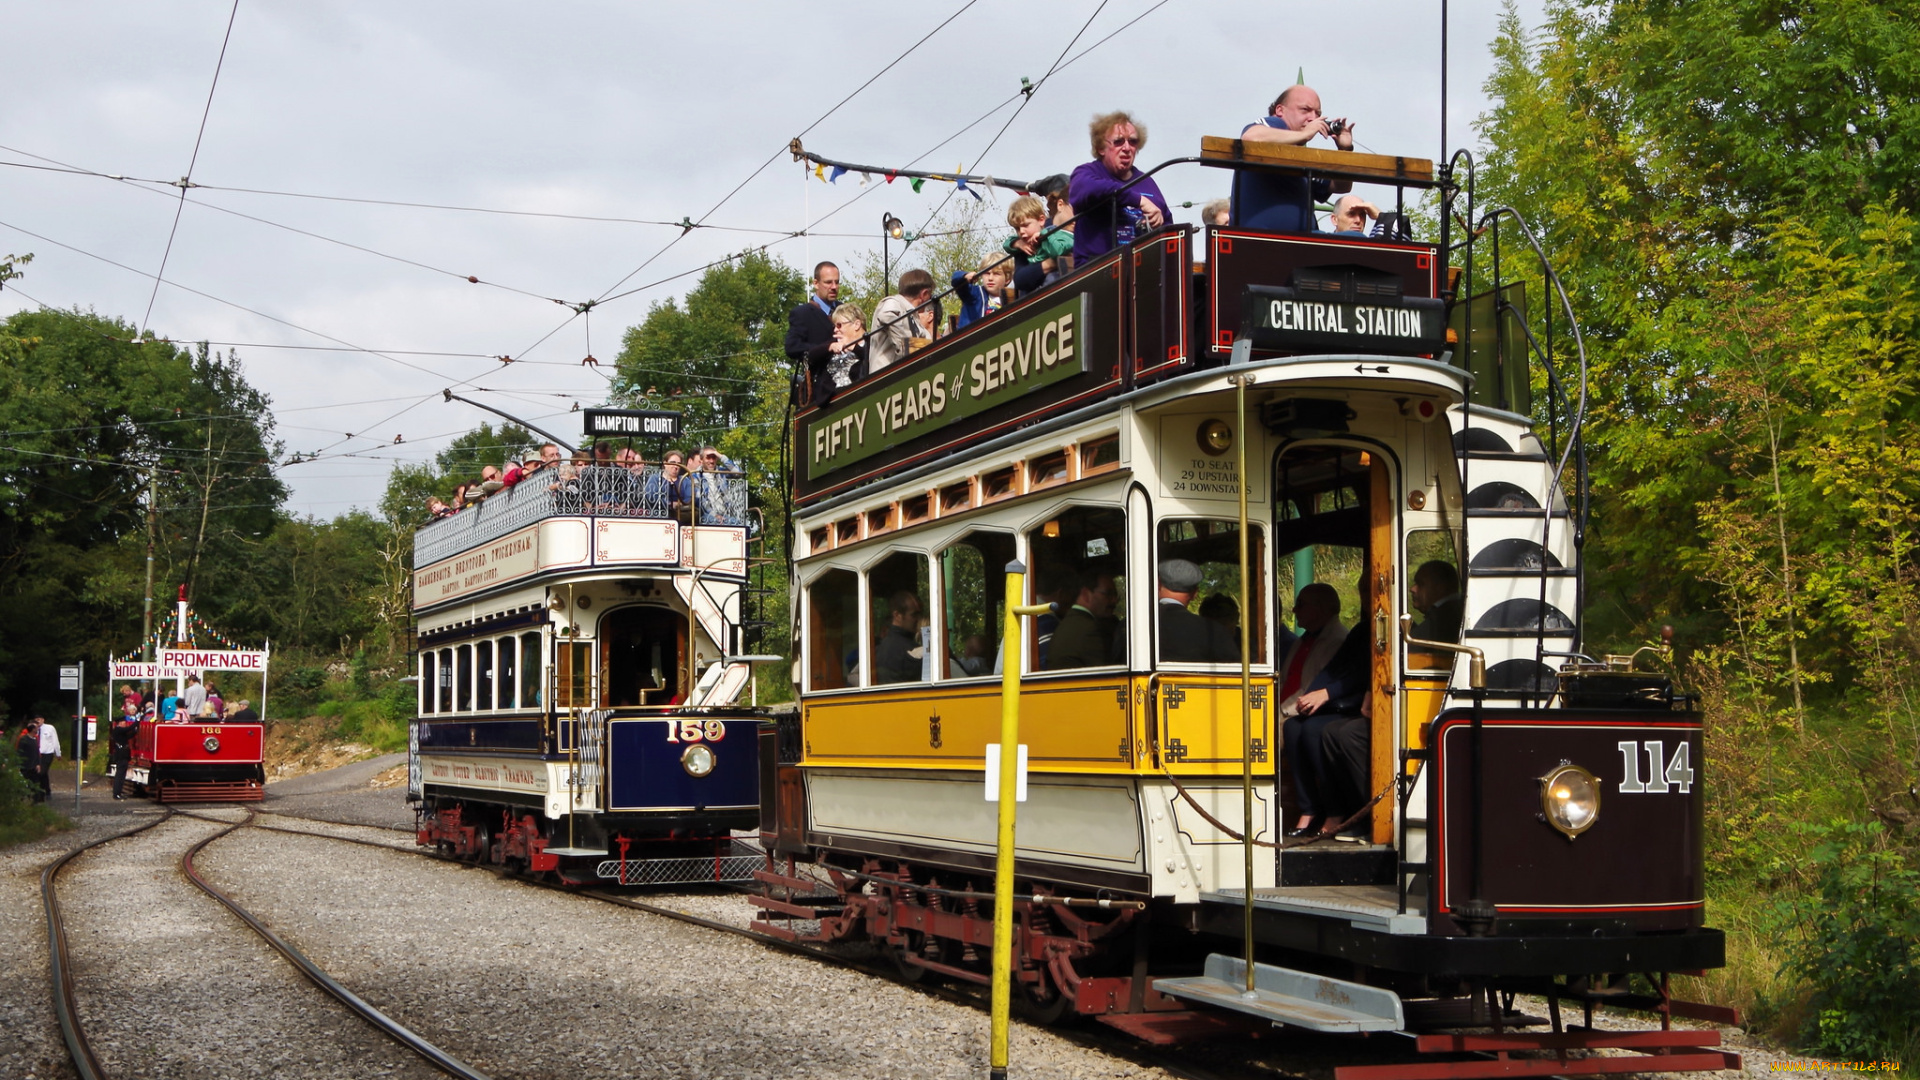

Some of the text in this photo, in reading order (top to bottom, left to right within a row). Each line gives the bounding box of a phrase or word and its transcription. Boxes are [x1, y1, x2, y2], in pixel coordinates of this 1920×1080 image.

[1270, 300, 1422, 338] CENTRAL STATION
[815, 312, 1075, 463] FIFTY YEARS of SERVICE
[594, 415, 673, 434] HAMPTON COURT
[1190, 459, 1236, 470] TO SEAT
[1181, 470, 1240, 483] 29 UPSTAIR
[1173, 481, 1252, 495] 24 DOWNSTAIS
[164, 652, 261, 668] PROMENADE
[115, 665, 143, 677] TOUR
[666, 720, 726, 744] 159
[1618, 740, 1694, 794] 114
